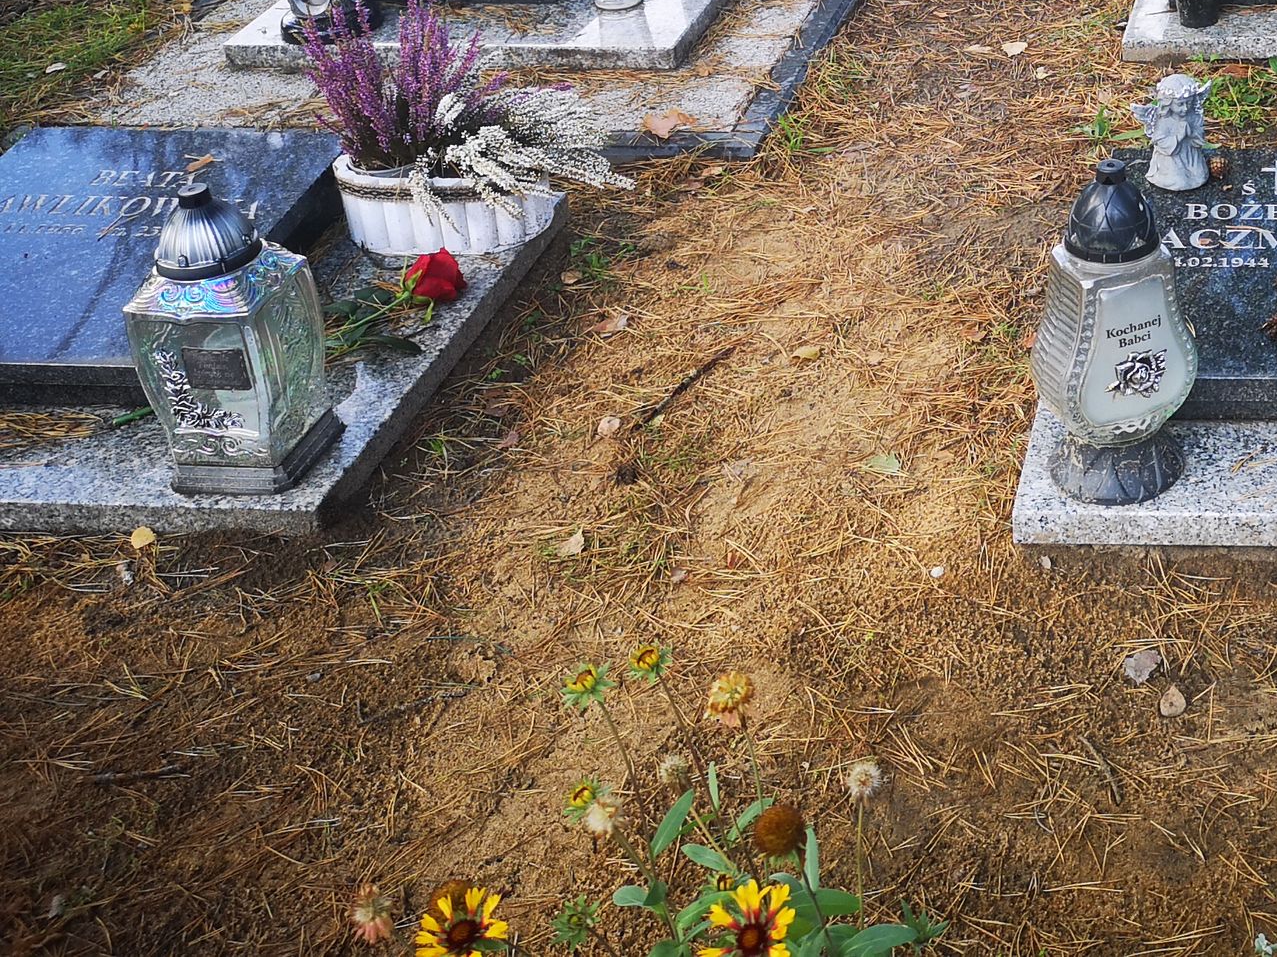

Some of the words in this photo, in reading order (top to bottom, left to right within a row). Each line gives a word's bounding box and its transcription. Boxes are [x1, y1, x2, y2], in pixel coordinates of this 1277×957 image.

[89, 169, 201, 188] BEATA
[1105, 314, 1162, 339] Kochanej
[1118, 330, 1152, 349] Babci
